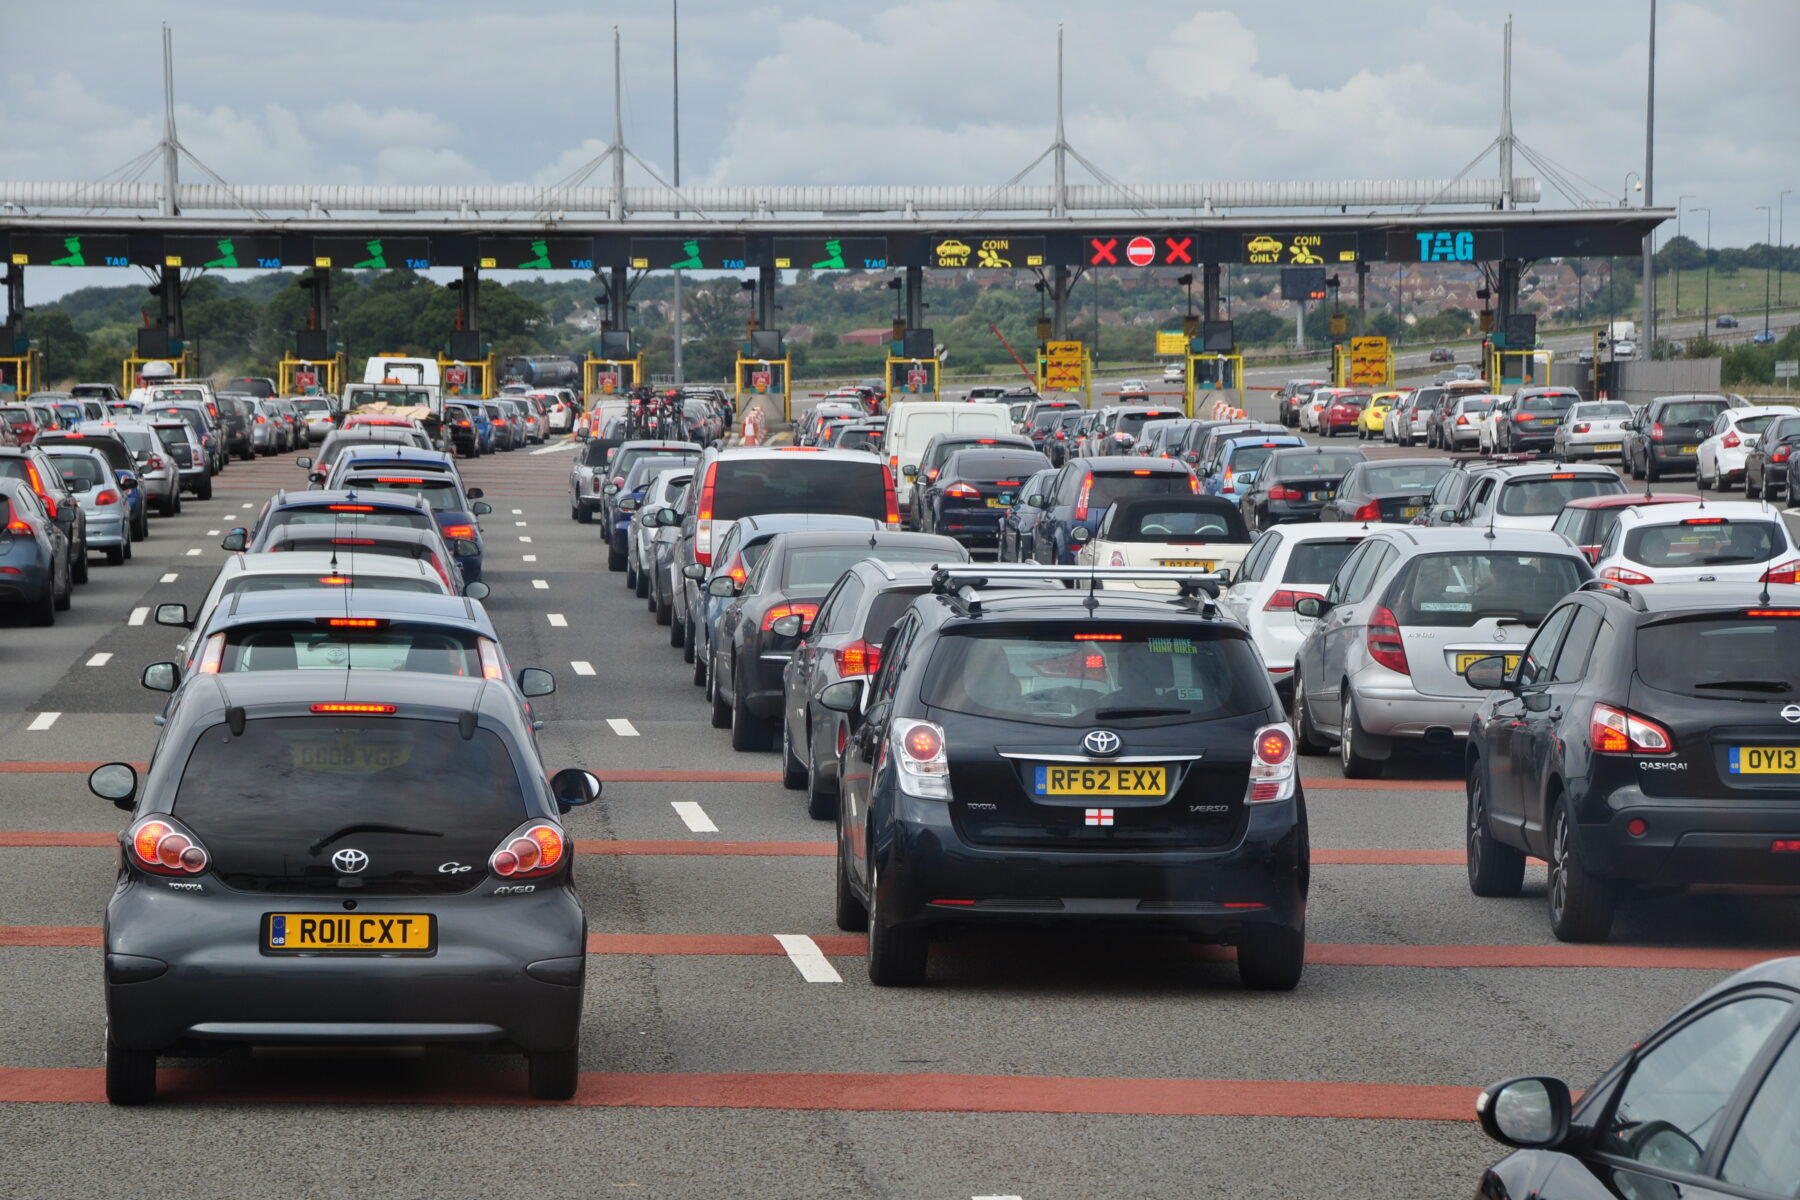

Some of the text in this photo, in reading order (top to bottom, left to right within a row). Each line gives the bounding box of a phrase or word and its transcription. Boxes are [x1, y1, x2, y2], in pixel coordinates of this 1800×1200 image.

[982, 240, 1009, 250] COIN
[1294, 236, 1321, 246] COIN
[1416, 231, 1474, 262] TAG
[105, 256, 128, 266] TAG
[257, 258, 281, 268] TAG
[405, 258, 429, 268] TAG
[570, 259, 593, 268] TAG
[722, 259, 745, 268] TAG
[864, 258, 887, 268] TAG
[938, 257, 968, 267] ONLY
[1250, 254, 1280, 263] ONLY
[1180, 689, 1187, 698] 5
[1748, 749, 1797, 769] OY13
[1639, 761, 1688, 771] QASHQAI
[1051, 769, 1161, 790] RF62 EXX
[967, 802, 997, 810] TOYOTA
[438, 861, 472, 874] Go
[168, 882, 203, 891] TOYOTA
[493, 885, 535, 894] AYGO
[300, 918, 413, 944] RO11 CXT
